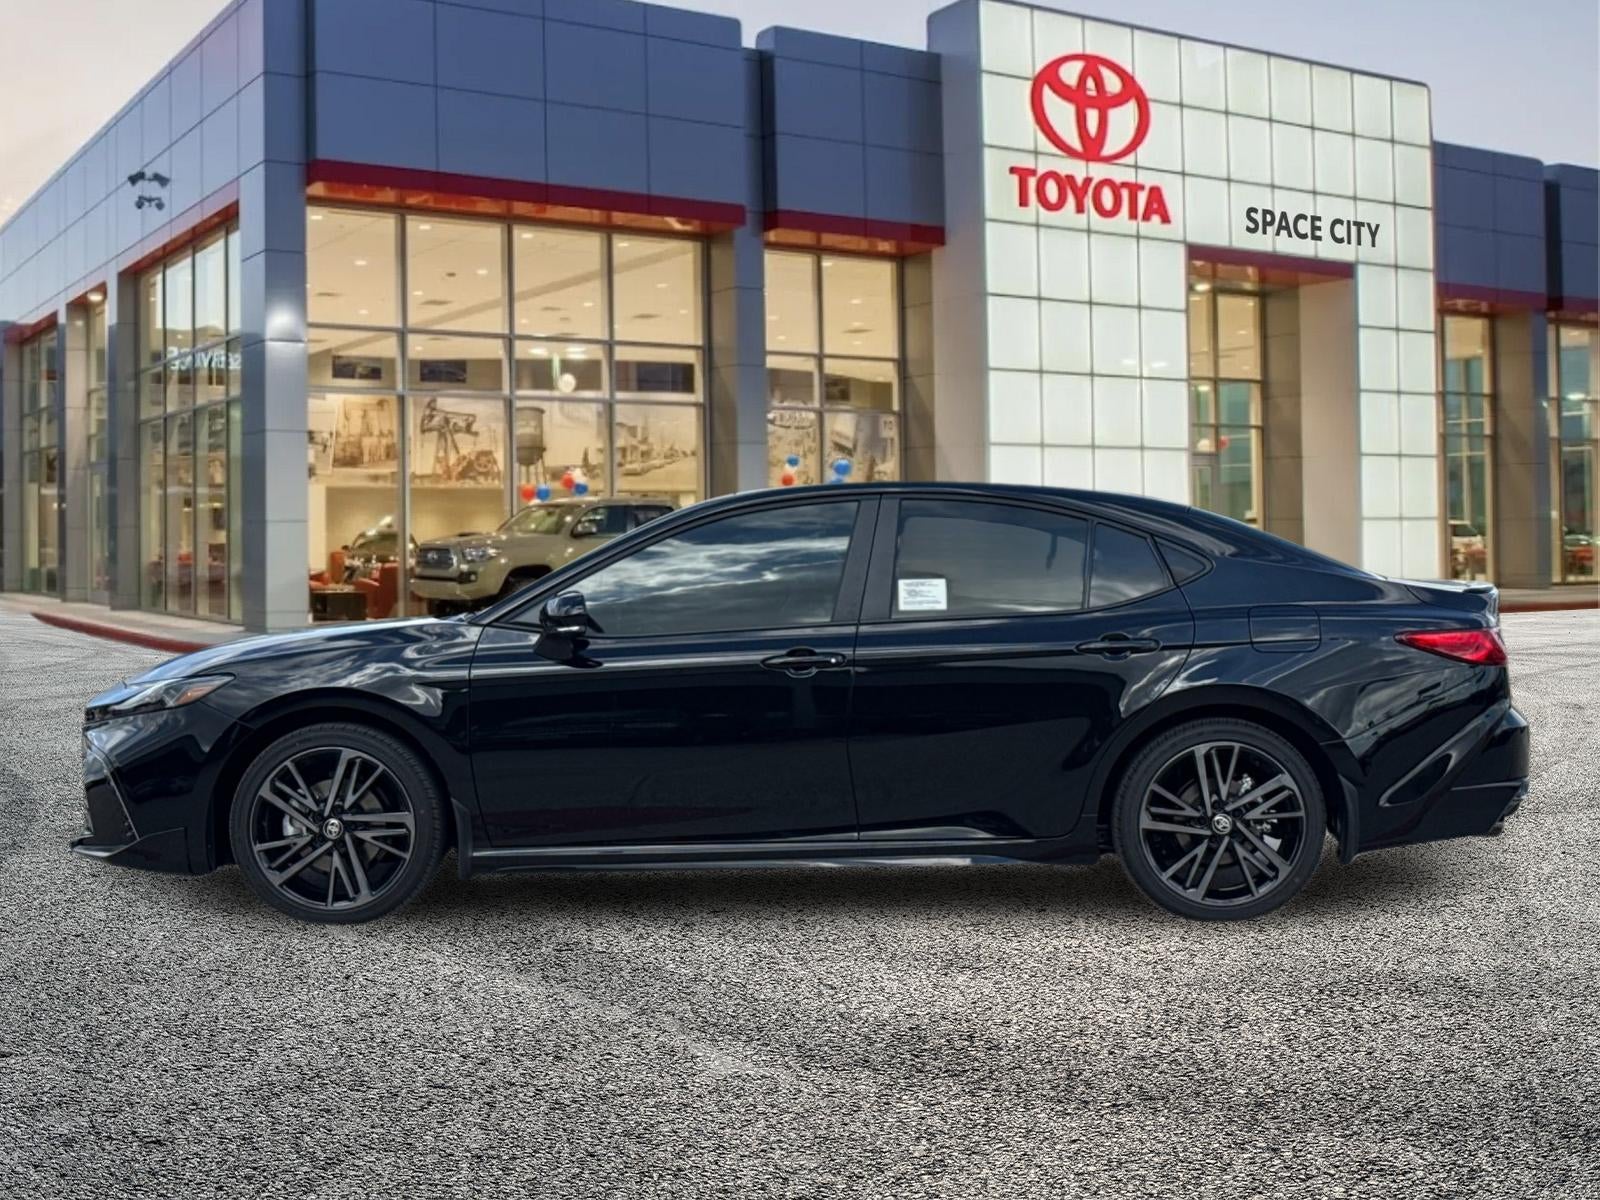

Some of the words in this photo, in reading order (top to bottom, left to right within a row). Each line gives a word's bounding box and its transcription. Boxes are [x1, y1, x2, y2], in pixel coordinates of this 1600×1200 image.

[1009, 166, 1171, 225] TOYOTA
[1245, 206, 1322, 242] SPACE
[1329, 217, 1381, 249] CITY
